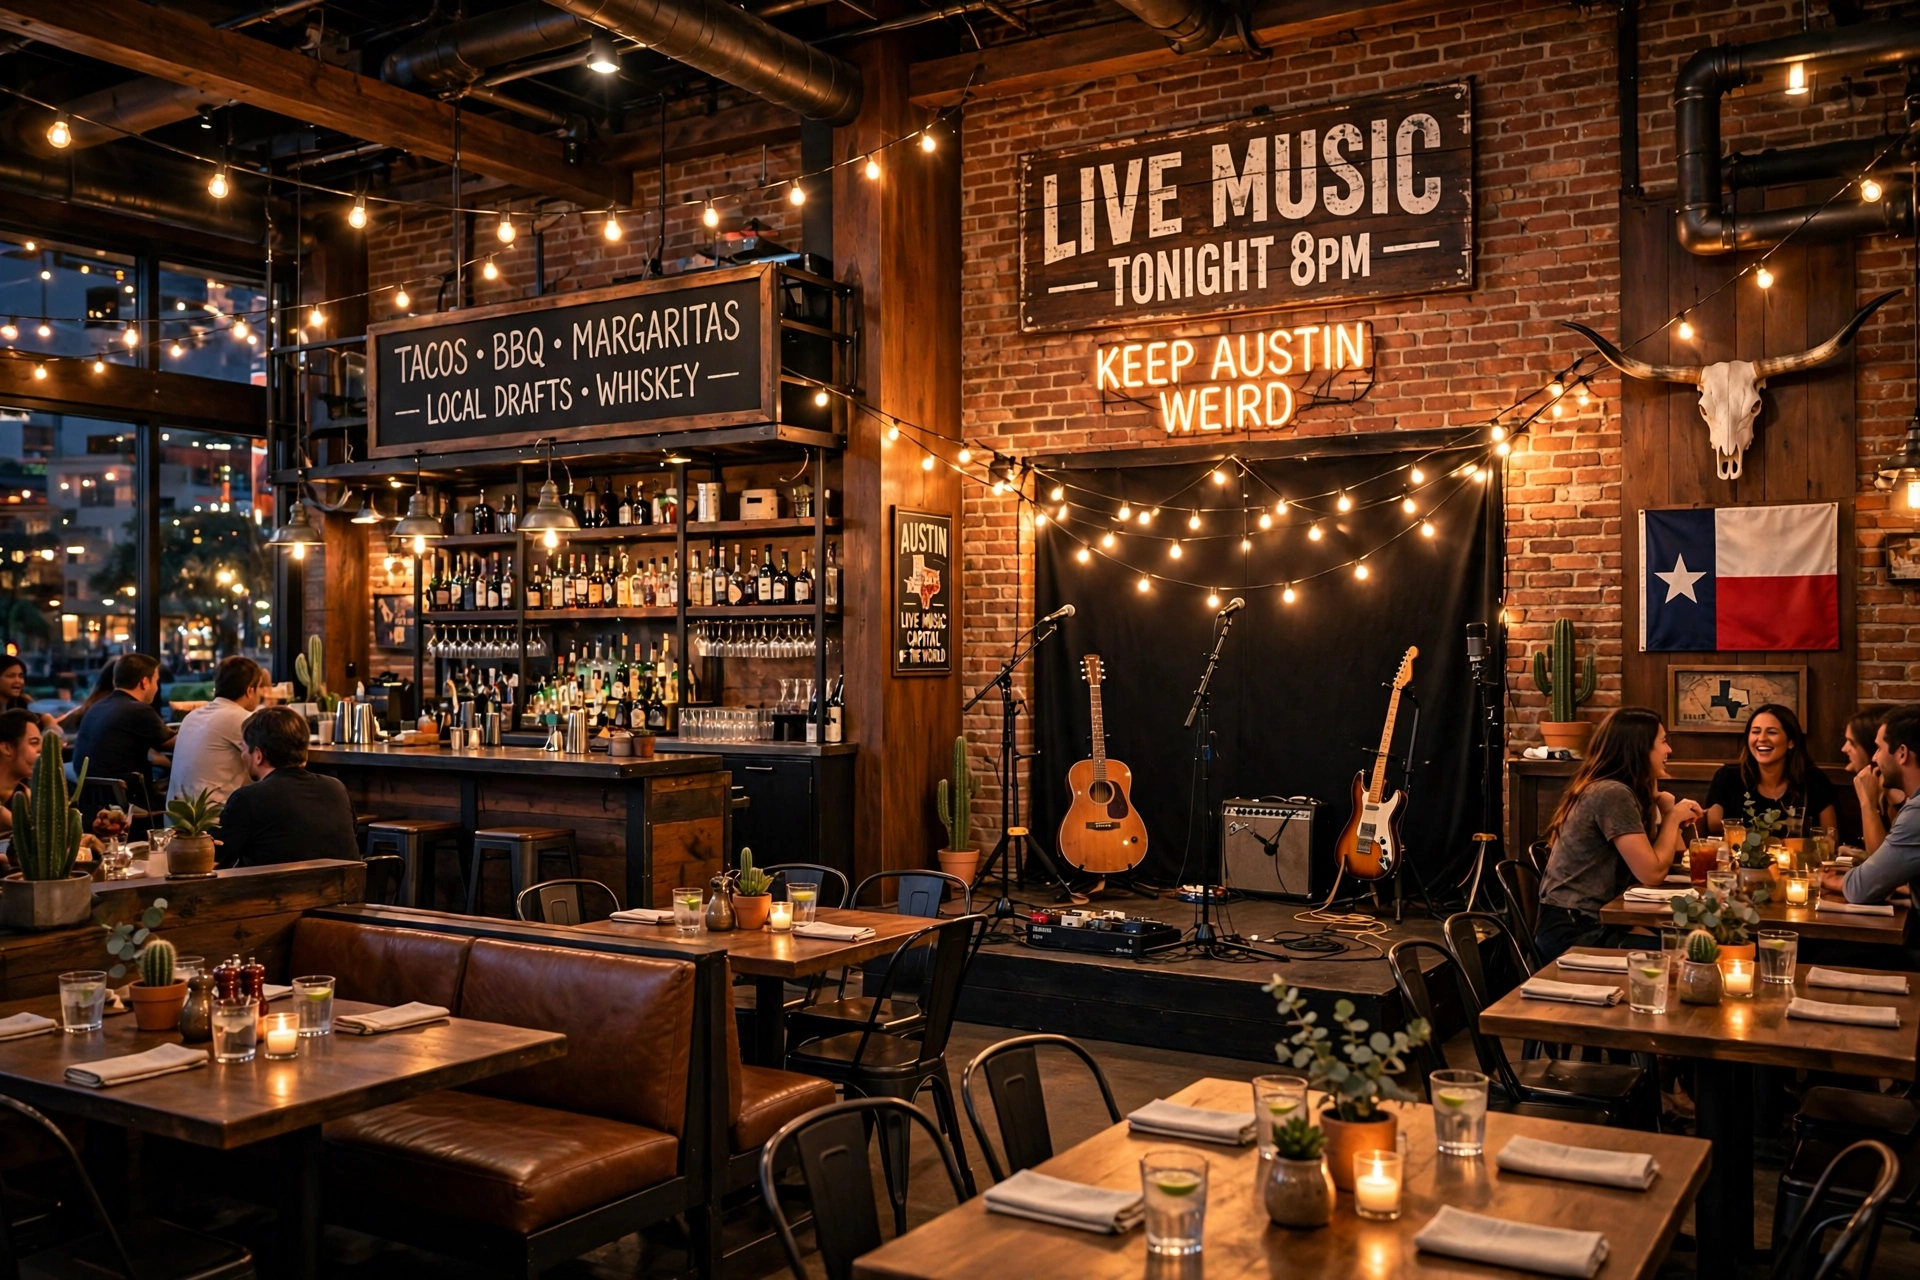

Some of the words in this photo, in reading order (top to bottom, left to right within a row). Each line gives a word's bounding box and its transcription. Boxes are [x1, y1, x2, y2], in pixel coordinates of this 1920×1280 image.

[1044, 151, 1182, 265] LIVE
[1211, 113, 1441, 227] MUSIC
[1108, 236, 1274, 306] TONIGHT
[1290, 231, 1370, 286] 8PM
[394, 338, 468, 384] TACOS
[493, 328, 545, 370] BBQ
[572, 299, 740, 360] MARGARITAS
[1096, 340, 1196, 391] KEEP
[1210, 322, 1365, 380] AUSTIN
[427, 389, 487, 425] LOCAL
[495, 378, 573, 418] DRAFTS
[596, 362, 700, 407] WHISKEY
[1159, 381, 1293, 433] WEIRD
[900, 522, 947, 558] AUSTIN
[901, 612, 919, 628] LIVE
[907, 630, 941, 647] CAPITAL
